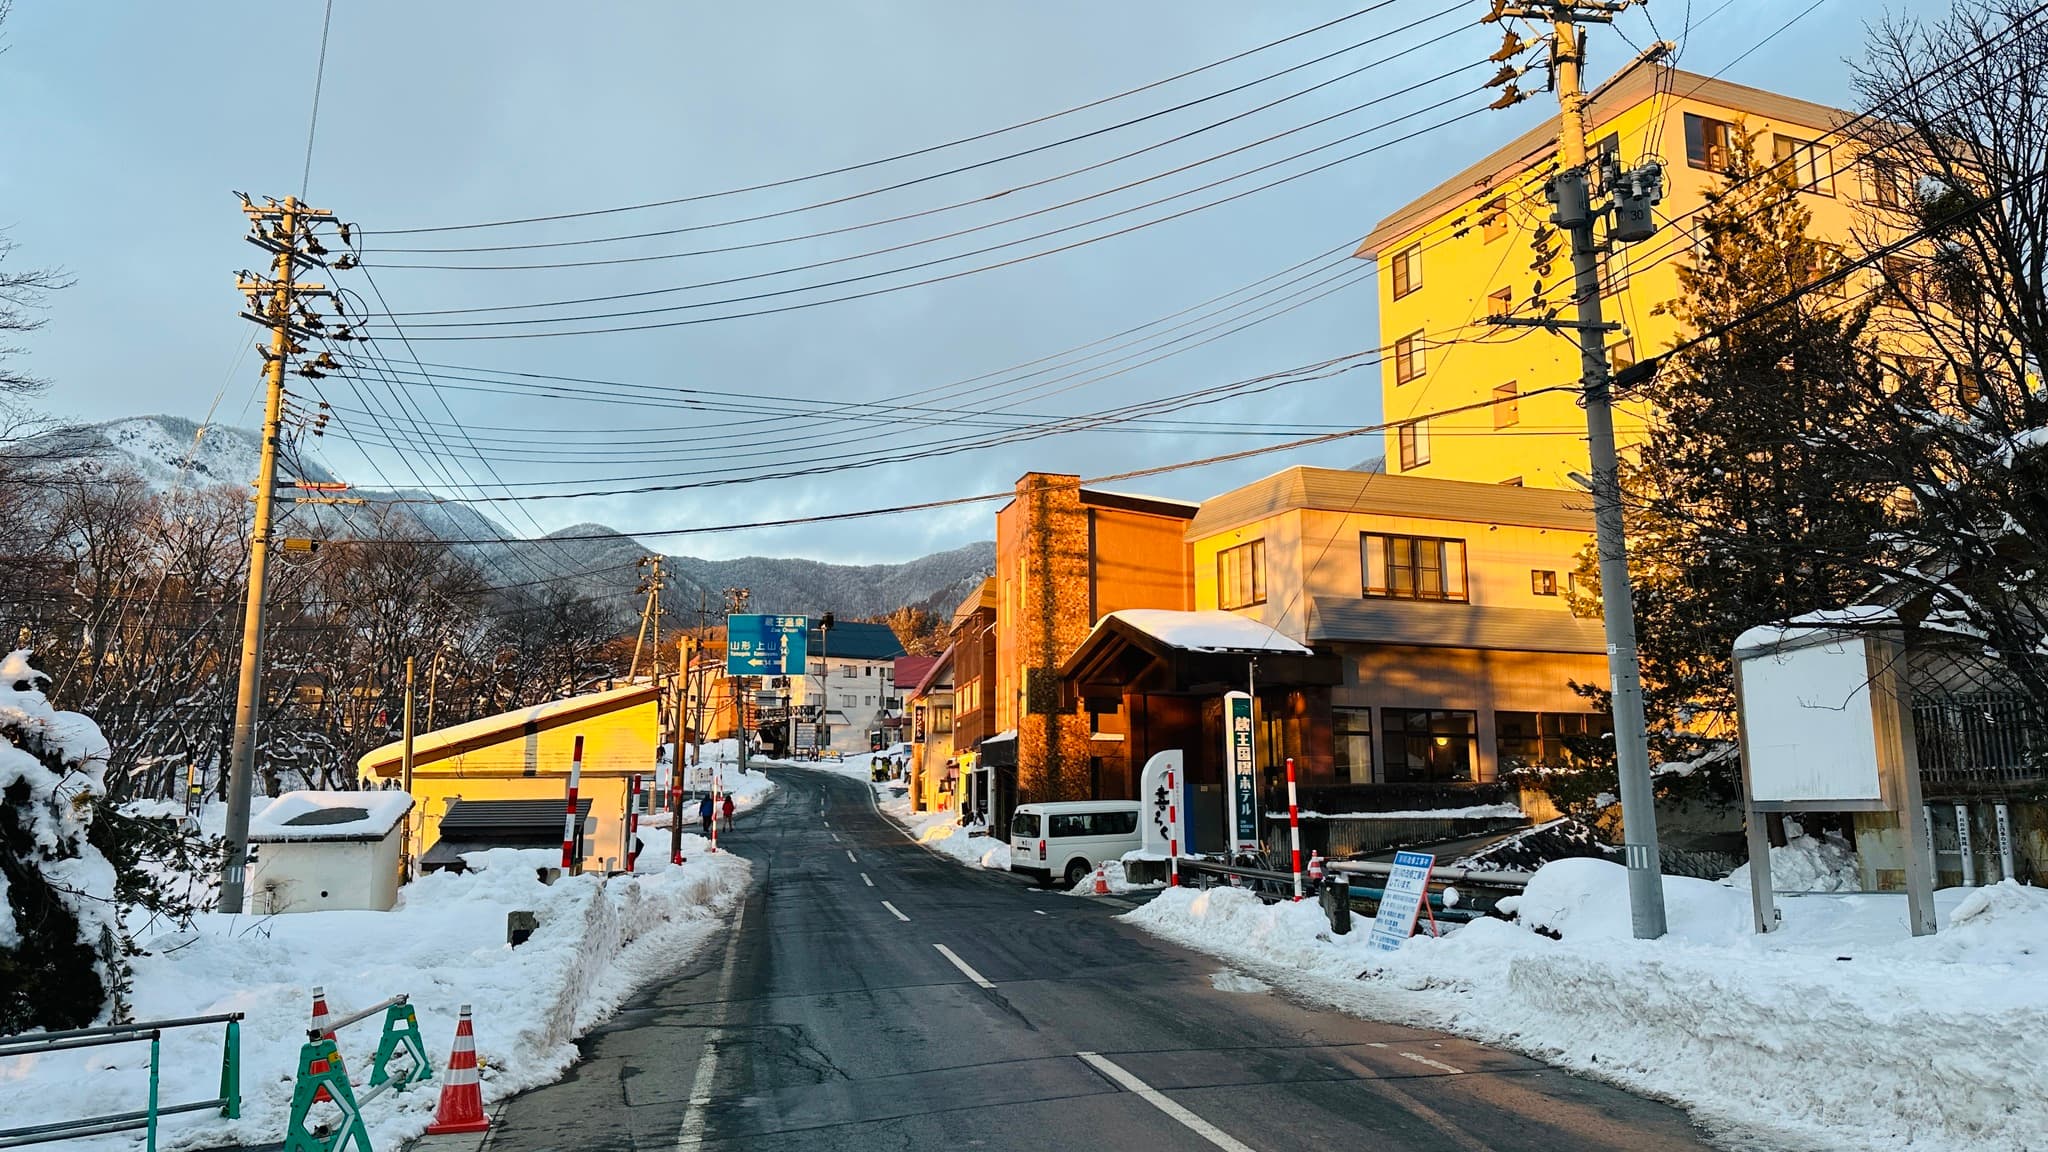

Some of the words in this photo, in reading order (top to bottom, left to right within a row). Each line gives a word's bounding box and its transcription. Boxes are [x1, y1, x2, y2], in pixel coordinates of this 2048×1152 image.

[1630, 209, 1644, 220] 30
[765, 617, 805, 627] 蔵王温泉
[730, 641, 751, 651] 山形
[756, 641, 776, 651] 上山
[1235, 716, 1251, 815] 蔵王国際ホテル
